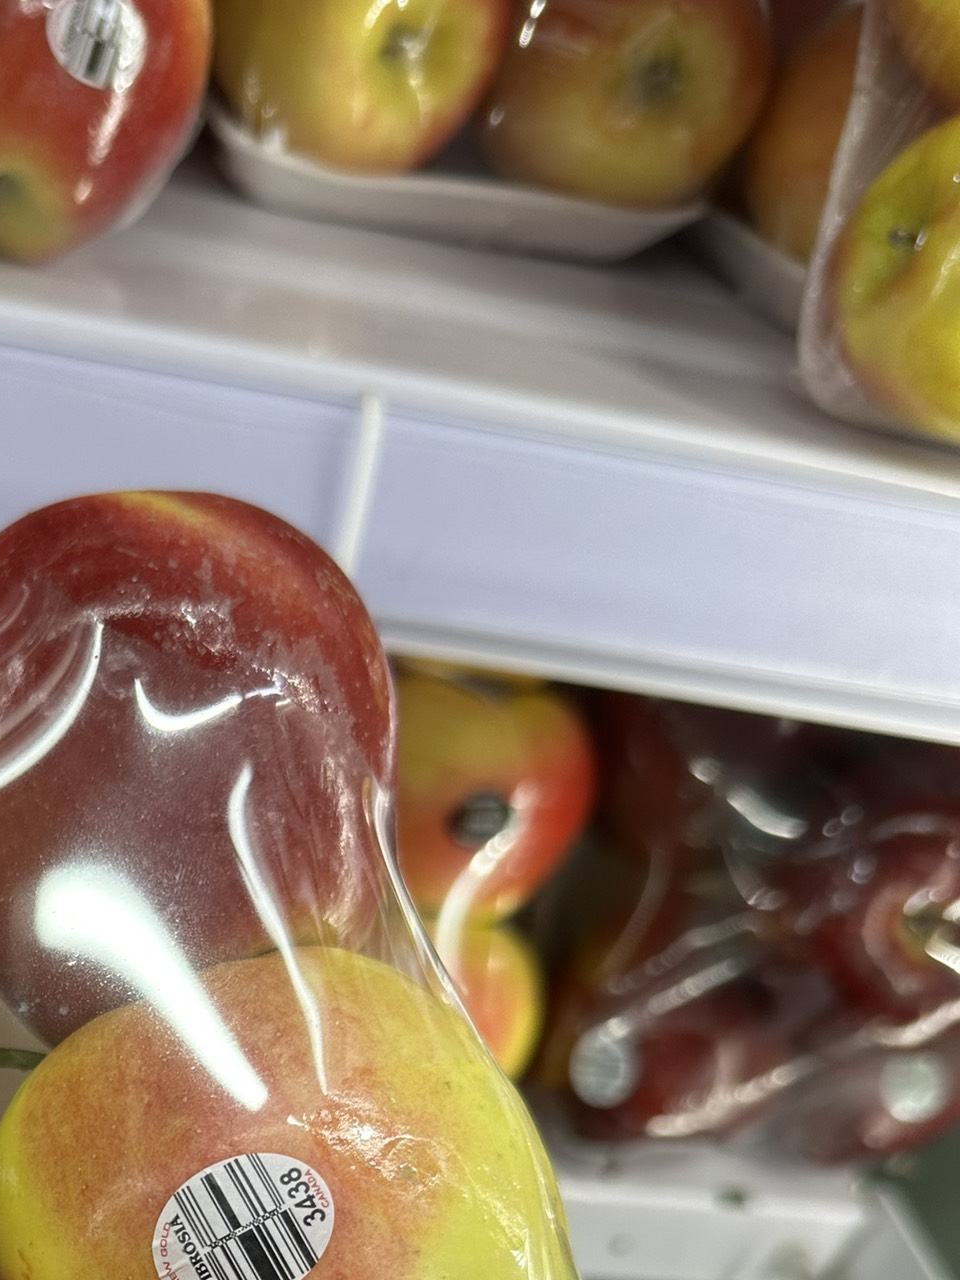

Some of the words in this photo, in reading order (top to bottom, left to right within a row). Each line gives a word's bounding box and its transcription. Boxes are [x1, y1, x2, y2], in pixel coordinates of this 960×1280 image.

[279, 1167, 326, 1227] 3438
[303, 1168, 330, 1208] CANADA
[159, 1221, 172, 1258] GOLD
